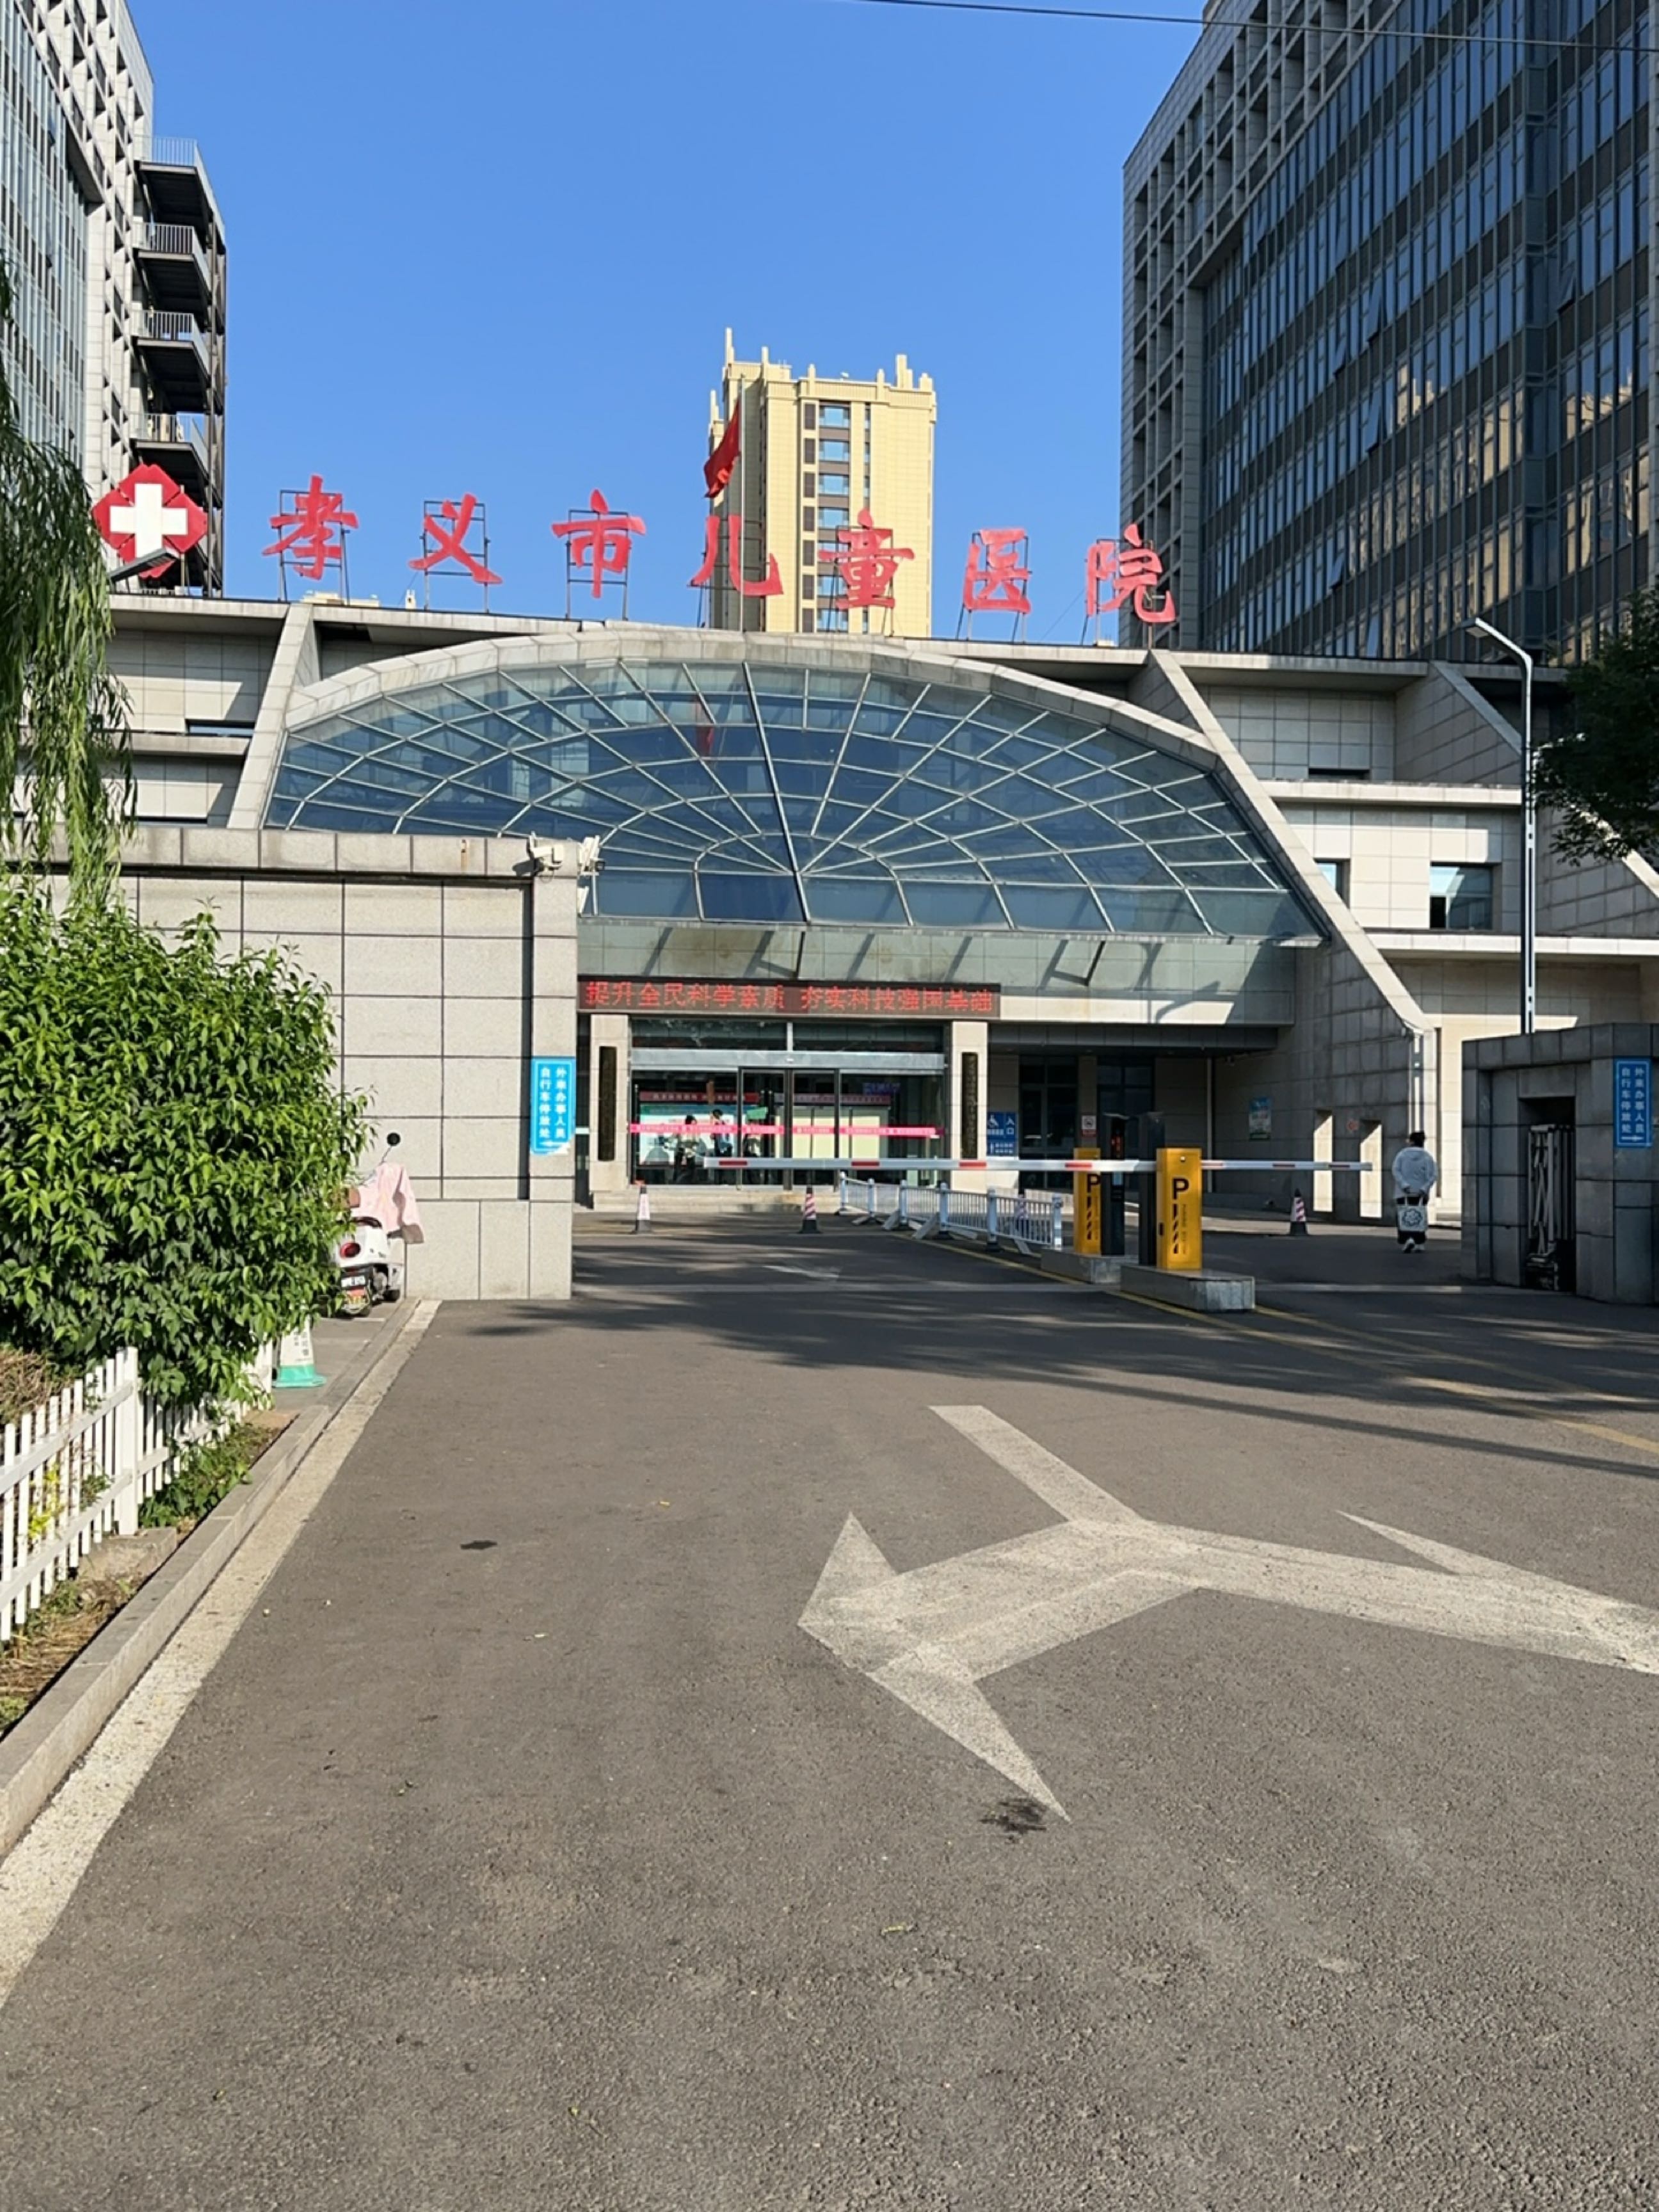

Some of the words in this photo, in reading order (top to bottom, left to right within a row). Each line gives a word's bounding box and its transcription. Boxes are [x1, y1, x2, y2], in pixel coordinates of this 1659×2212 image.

[263, 475, 1176, 623] 孝义市儿童医院
[585, 981, 785, 1009] 提升全民科学素质
[1087, 1174, 1101, 1193] P
[1172, 1177, 1189, 1200] P
